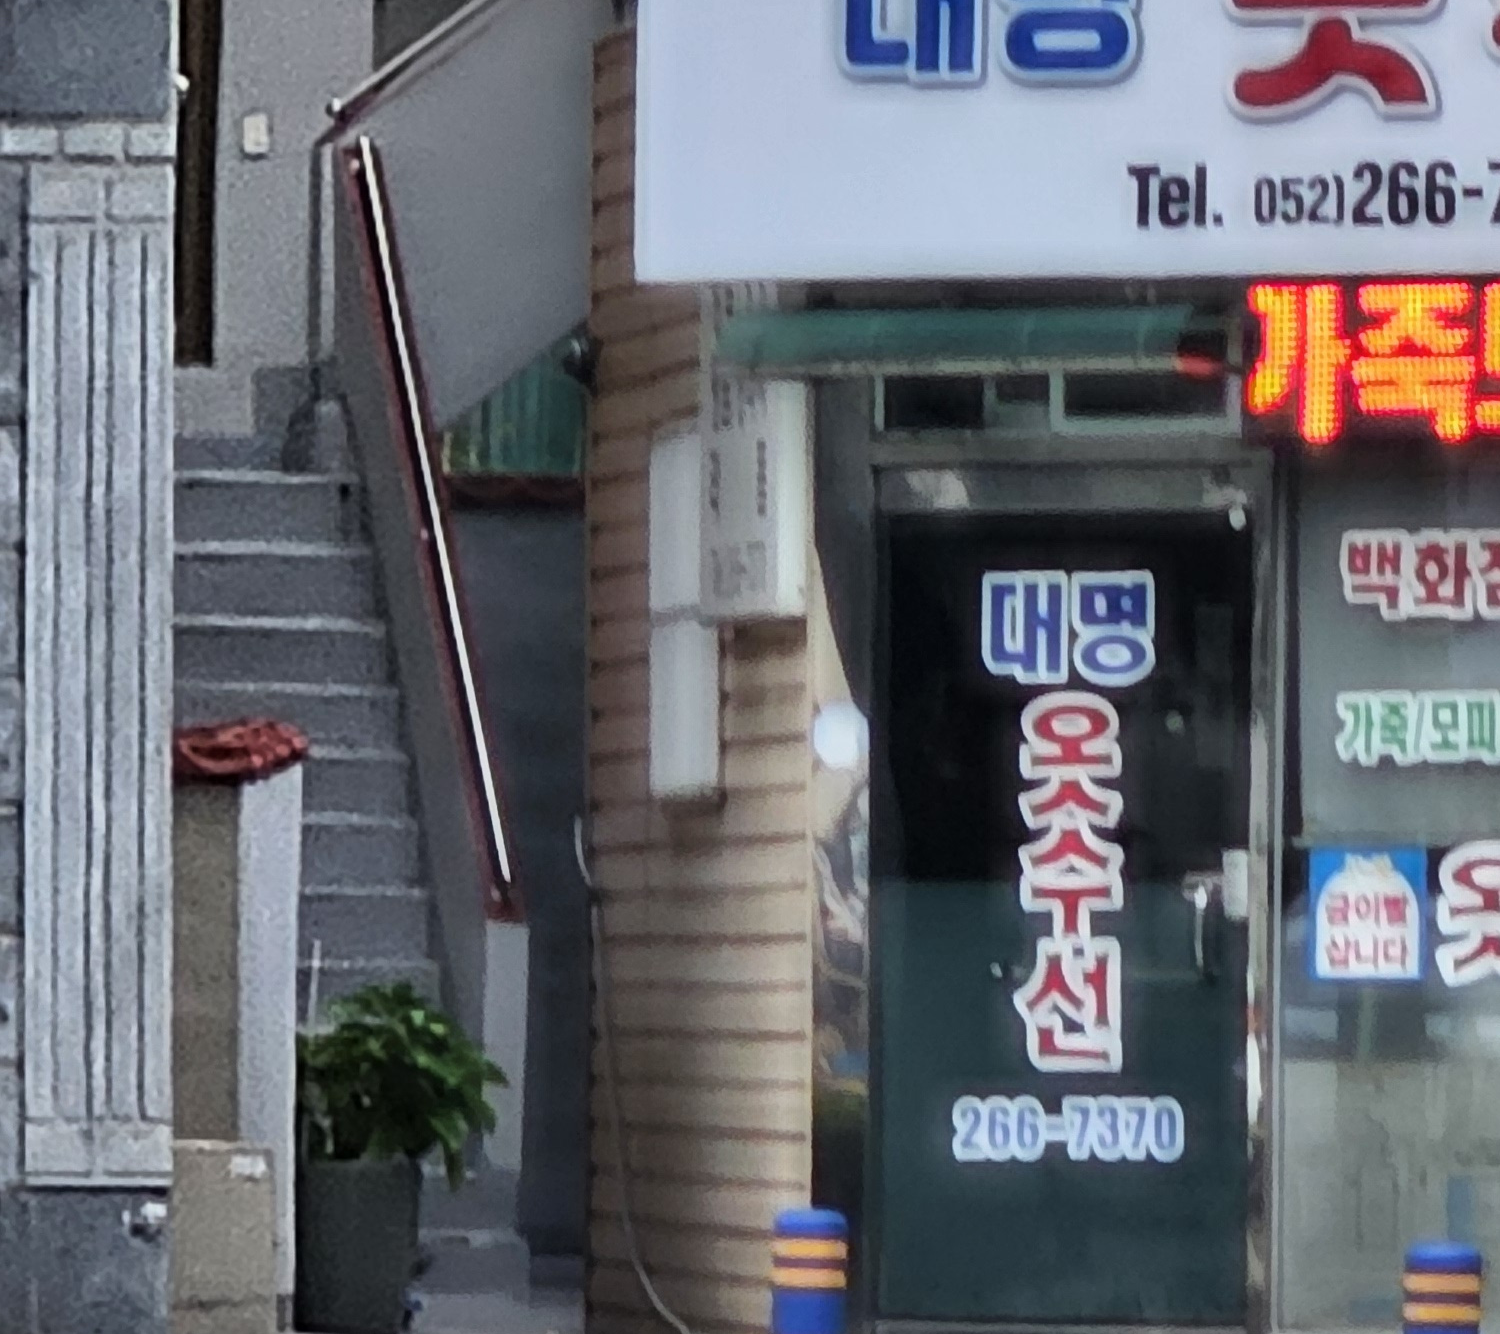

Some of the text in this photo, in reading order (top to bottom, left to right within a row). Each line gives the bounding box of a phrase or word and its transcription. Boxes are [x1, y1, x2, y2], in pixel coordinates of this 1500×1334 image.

[1128, 162, 1224, 228] Tel.
[982, 570, 1156, 685] 대명
[1013, 690, 1124, 1072] 옷수선
[952, 1093, 1184, 1163] 266-7370
